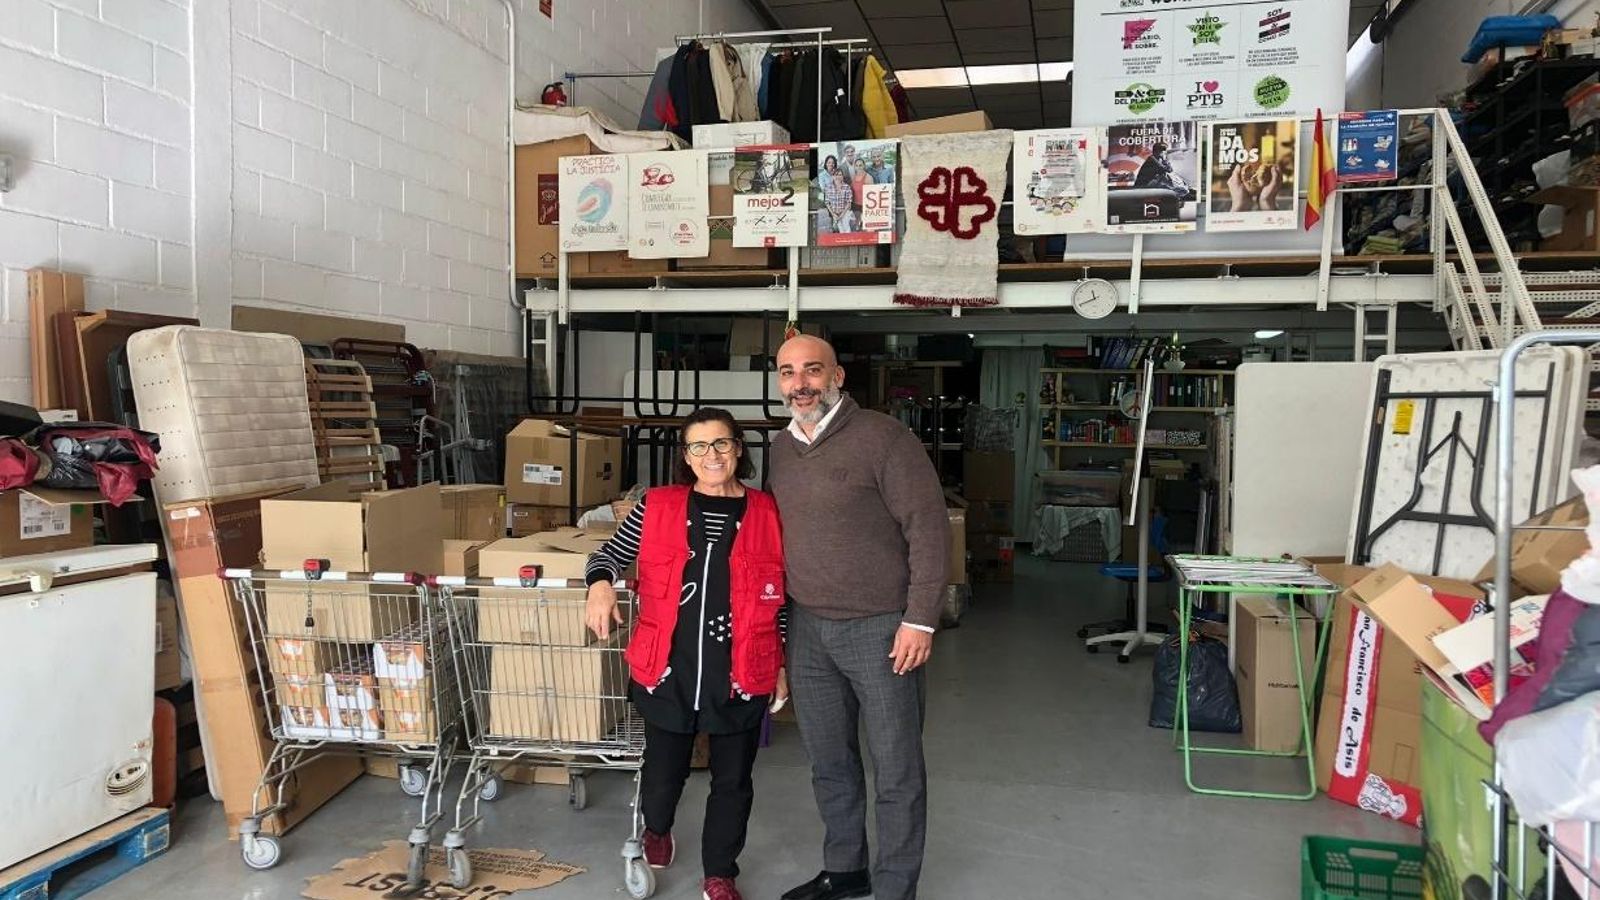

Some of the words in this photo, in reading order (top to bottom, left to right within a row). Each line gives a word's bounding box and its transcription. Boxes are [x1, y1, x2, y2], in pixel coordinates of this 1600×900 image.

[1267, 8, 1283, 17] SOY
[1195, 16, 1219, 24] VISTO
[1195, 81, 1203, 93] I
[1186, 93, 1224, 106] PTB
[1131, 127, 1161, 137] FUERA
[1162, 126, 1174, 135] DE
[1219, 135, 1244, 151] DA
[1218, 147, 1259, 163] MOS
[567, 166, 577, 175] LA
[866, 185, 890, 209] SÉ
[865, 209, 889, 218] PARTE
[1363, 615, 1371, 630] an
[1351, 706, 1362, 723] de
